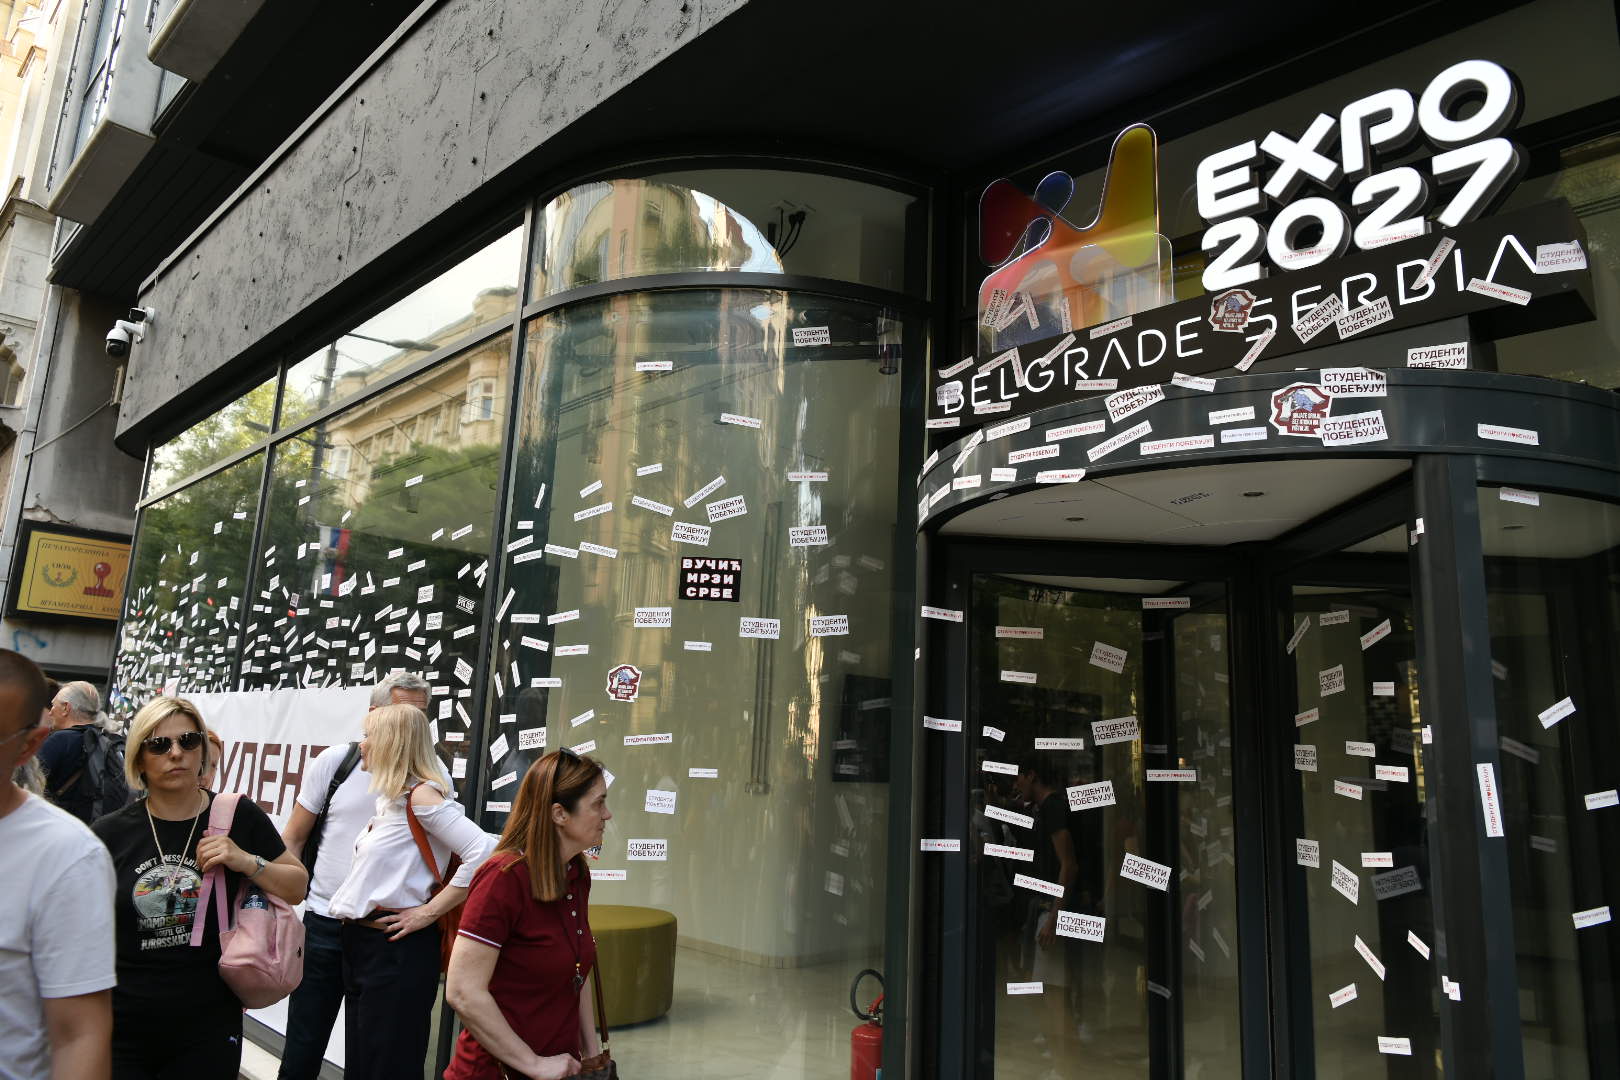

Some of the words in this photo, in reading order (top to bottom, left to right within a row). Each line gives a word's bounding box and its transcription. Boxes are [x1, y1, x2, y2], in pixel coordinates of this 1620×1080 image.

[1197, 59, 1512, 220] EXPO
[1201, 137, 1514, 291] 2027
[1540, 248, 1584, 259] СТУДЕНТИ
[1295, 297, 1339, 332] СТУДЕНТИ
[1338, 300, 1388, 327] СТУДЕНТИ
[944, 316, 1204, 414] BELGRADE
[1243, 234, 1537, 345] SERBIA
[1300, 303, 1345, 342] ПОБЕЂУЈУ!
[1340, 310, 1393, 337] ПОБЕЂУЈУ!
[795, 329, 828, 337] СТУДЕНТИ
[1410, 347, 1465, 360] СТУДЕНТИ
[1409, 358, 1466, 369] ПОБЕЂУЈУ!
[1324, 371, 1384, 382] СТУДЕНТИ
[1111, 389, 1162, 419] ПОБЕЂУЈУ!
[1324, 416, 1380, 432] СТУДЕНТИ
[1322, 426, 1386, 442] ПОБЕЂУЈУ!
[708, 499, 743, 512] СТУДЕНТИ
[710, 506, 745, 521] ПОБЕЂУЈУ!
[675, 524, 710, 535] СТУДЕНТИ
[791, 529, 826, 537] СТУДЕНТИ
[672, 532, 708, 544] ПОБЕЂУЈУ!
[791, 536, 827, 545] ПОБЕЂУЈУ!
[682, 559, 741, 570] ВУЧИЋ
[687, 572, 734, 584] МРЗИ
[686, 587, 733, 599] СРБЕ
[742, 620, 778, 629] СТУДЕНТИ
[812, 618, 847, 626] СТУДЕНТИ
[740, 627, 779, 635] ПОБЕЂУЈУ!
[1095, 721, 1135, 733] СТУДЕНТИ
[1094, 728, 1138, 740] ПОБЕЂУЈУ!
[219, 740, 330, 817] УДЕН
[1070, 785, 1111, 799] СТУДЕНТИ
[1070, 792, 1115, 806] ПОБЕЂУЈУ!
[134, 857, 158, 874] DON'T
[183, 857, 200, 871] WIT
[1126, 858, 1167, 877] СТУДЕНТИ
[1122, 864, 1168, 885] ПОБЕЂУЈУ!
[1060, 915, 1102, 928] СТУДЕНТИ
[1057, 922, 1103, 938] ПОБЕЂУЈУ!
